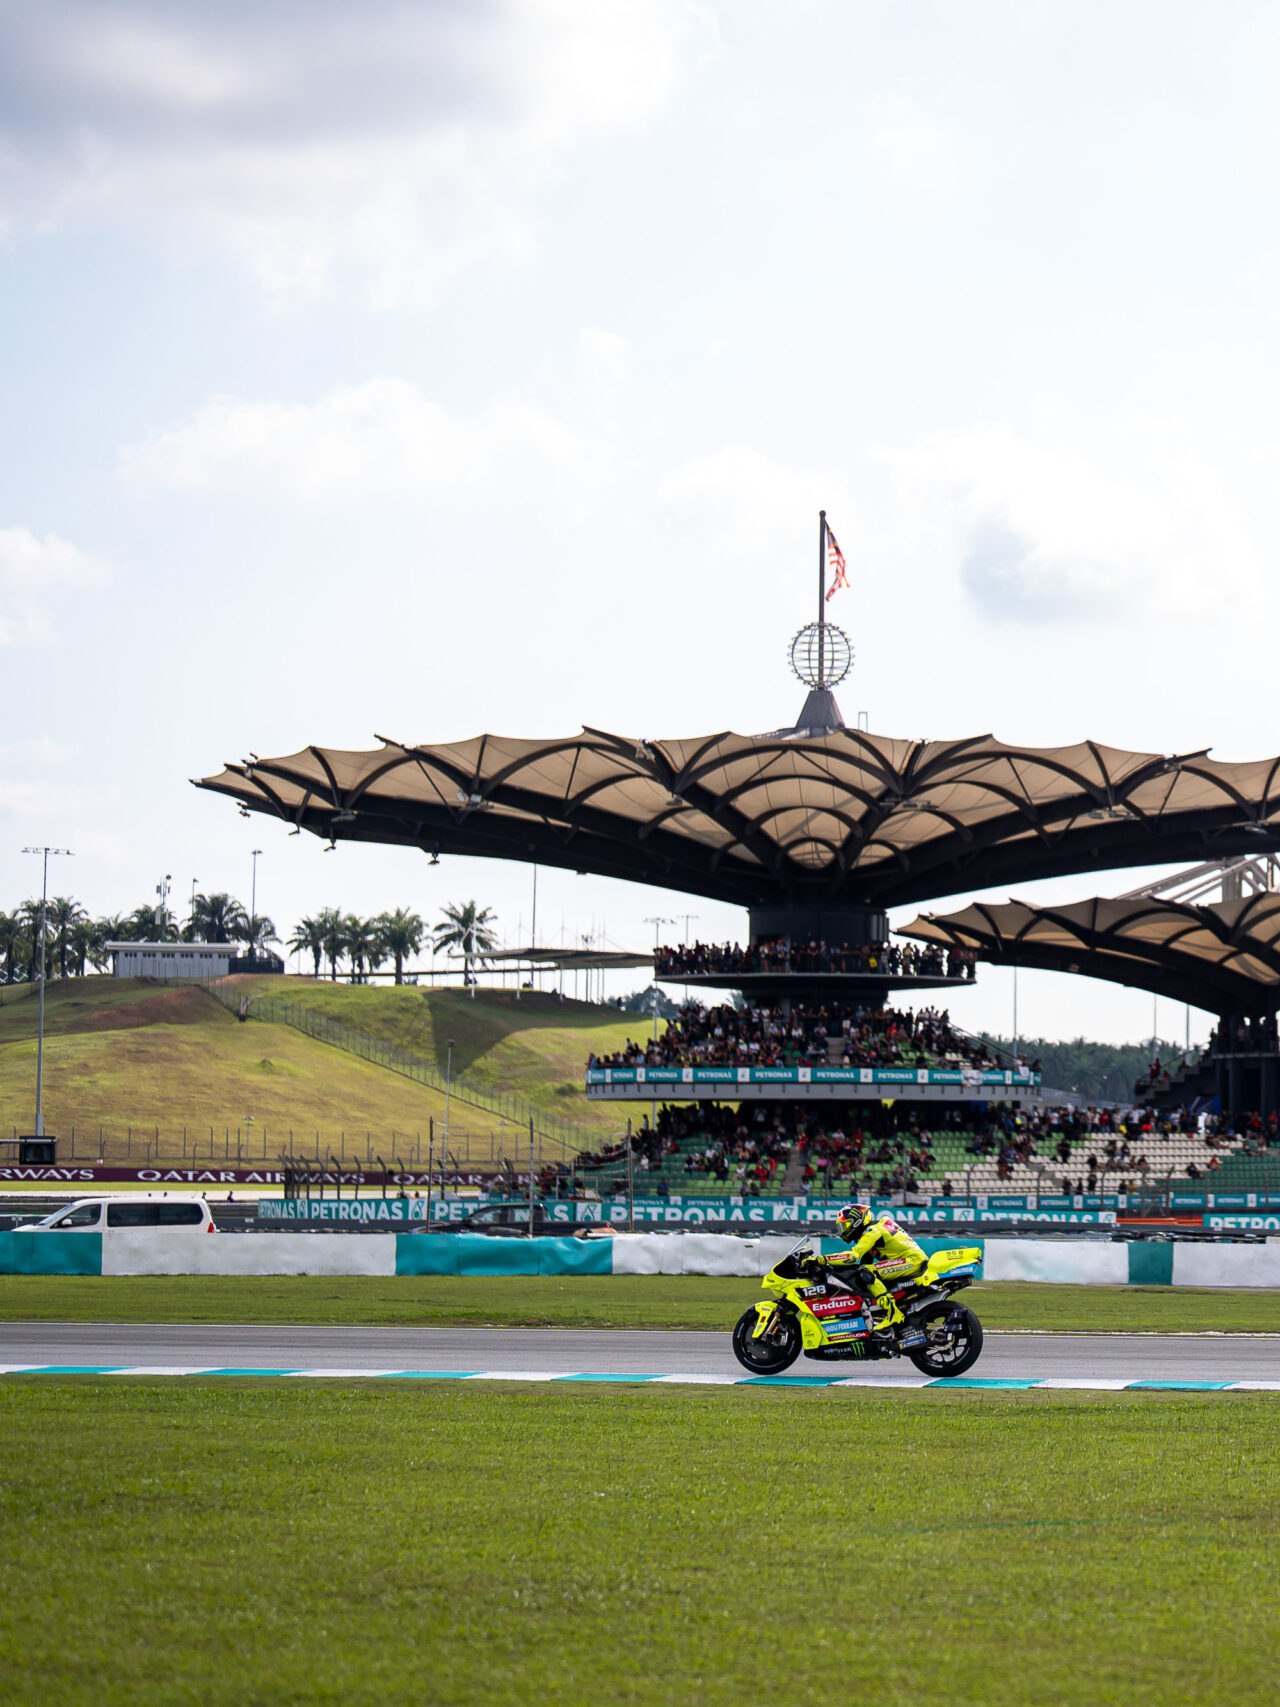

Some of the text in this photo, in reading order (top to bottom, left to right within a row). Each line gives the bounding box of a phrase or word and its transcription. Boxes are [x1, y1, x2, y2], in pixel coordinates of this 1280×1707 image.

[816, 1071, 854, 1079] PETRONAS
[137, 1170, 236, 1182] QATAR
[311, 1201, 403, 1220] PETRONAS
[610, 1206, 765, 1222] PETRONAS
[806, 1209, 951, 1221] PEONAS
[812, 1299, 856, 1311] Enduro
